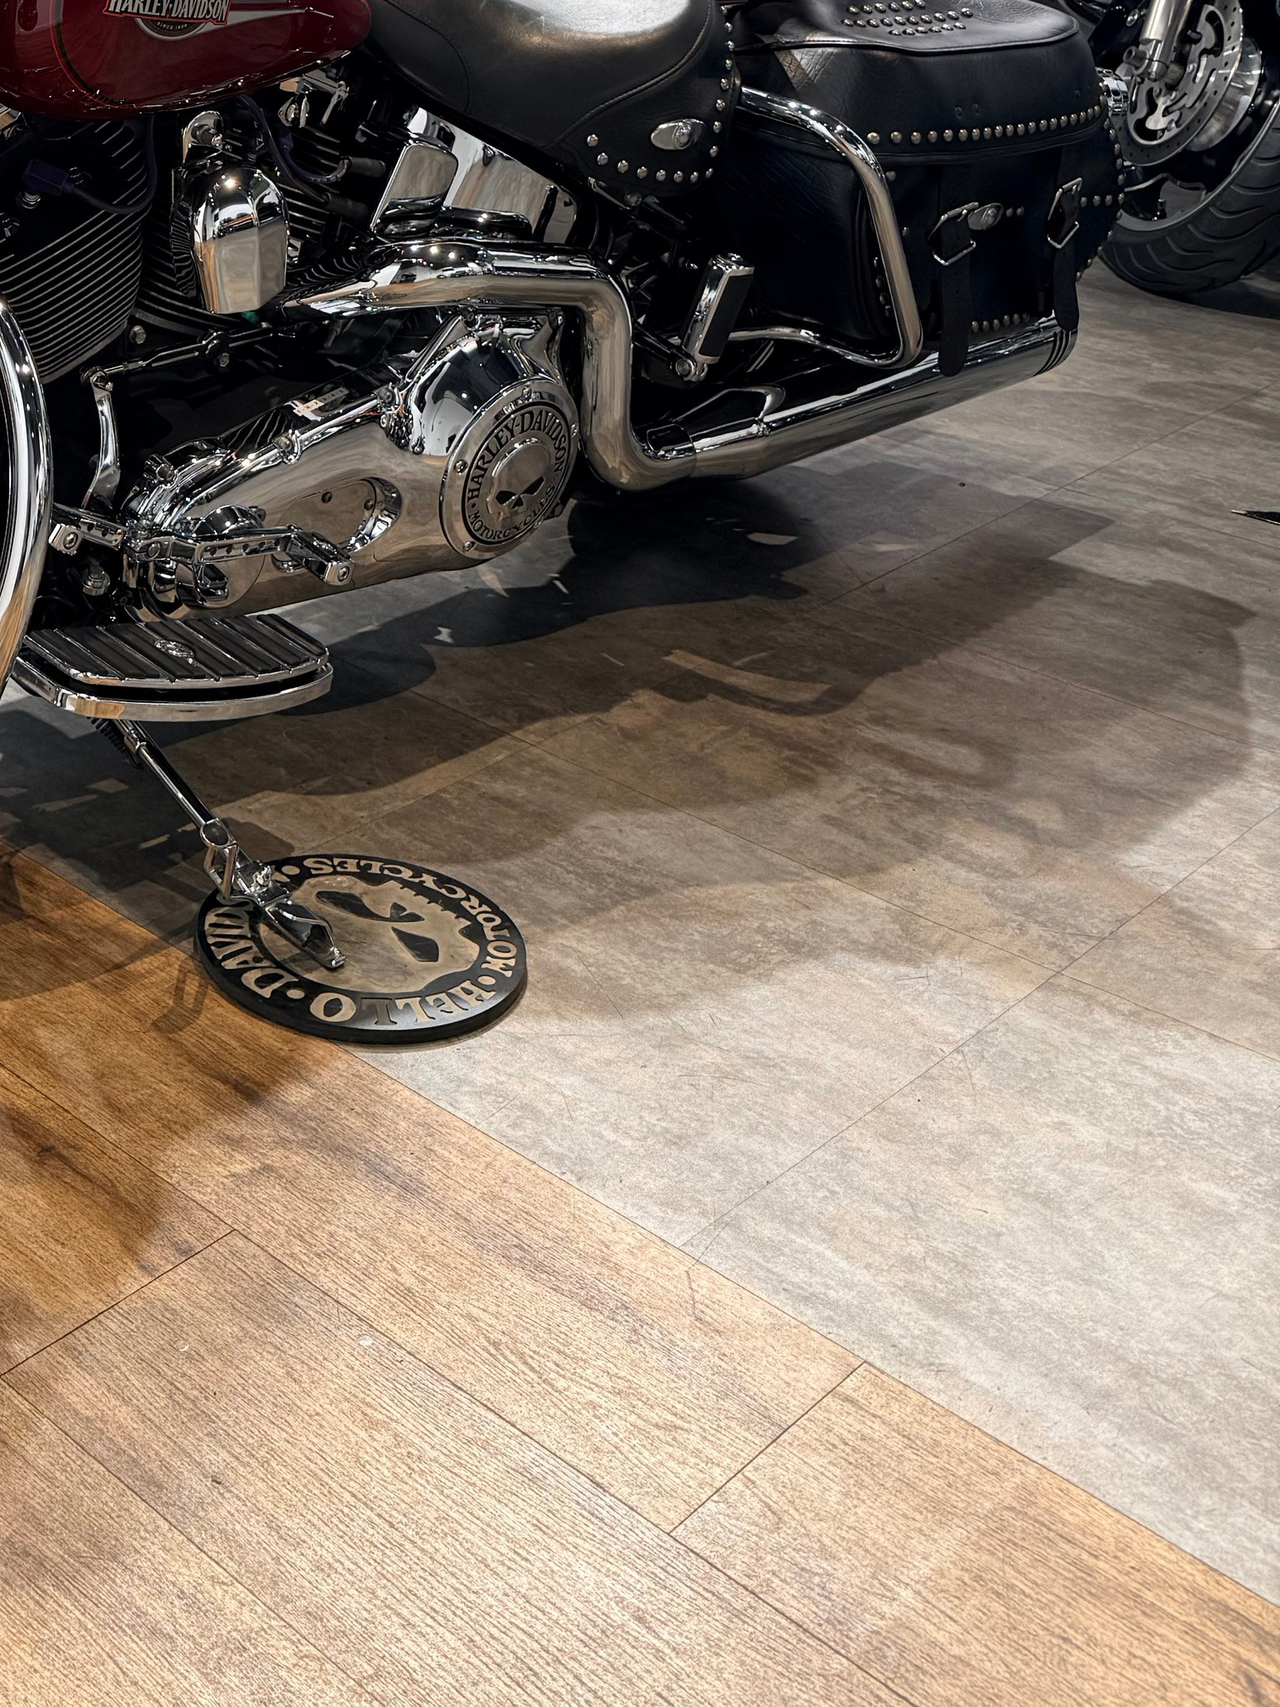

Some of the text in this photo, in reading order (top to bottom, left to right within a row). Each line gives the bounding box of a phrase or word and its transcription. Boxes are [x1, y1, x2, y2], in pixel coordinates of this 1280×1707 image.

[468, 409, 568, 506] HARLEY-DAVIDSON
[469, 485, 555, 541] MOTORCYCLES
[303, 857, 518, 978] MOTORCYCLES
[309, 979, 497, 1026] HELLO
